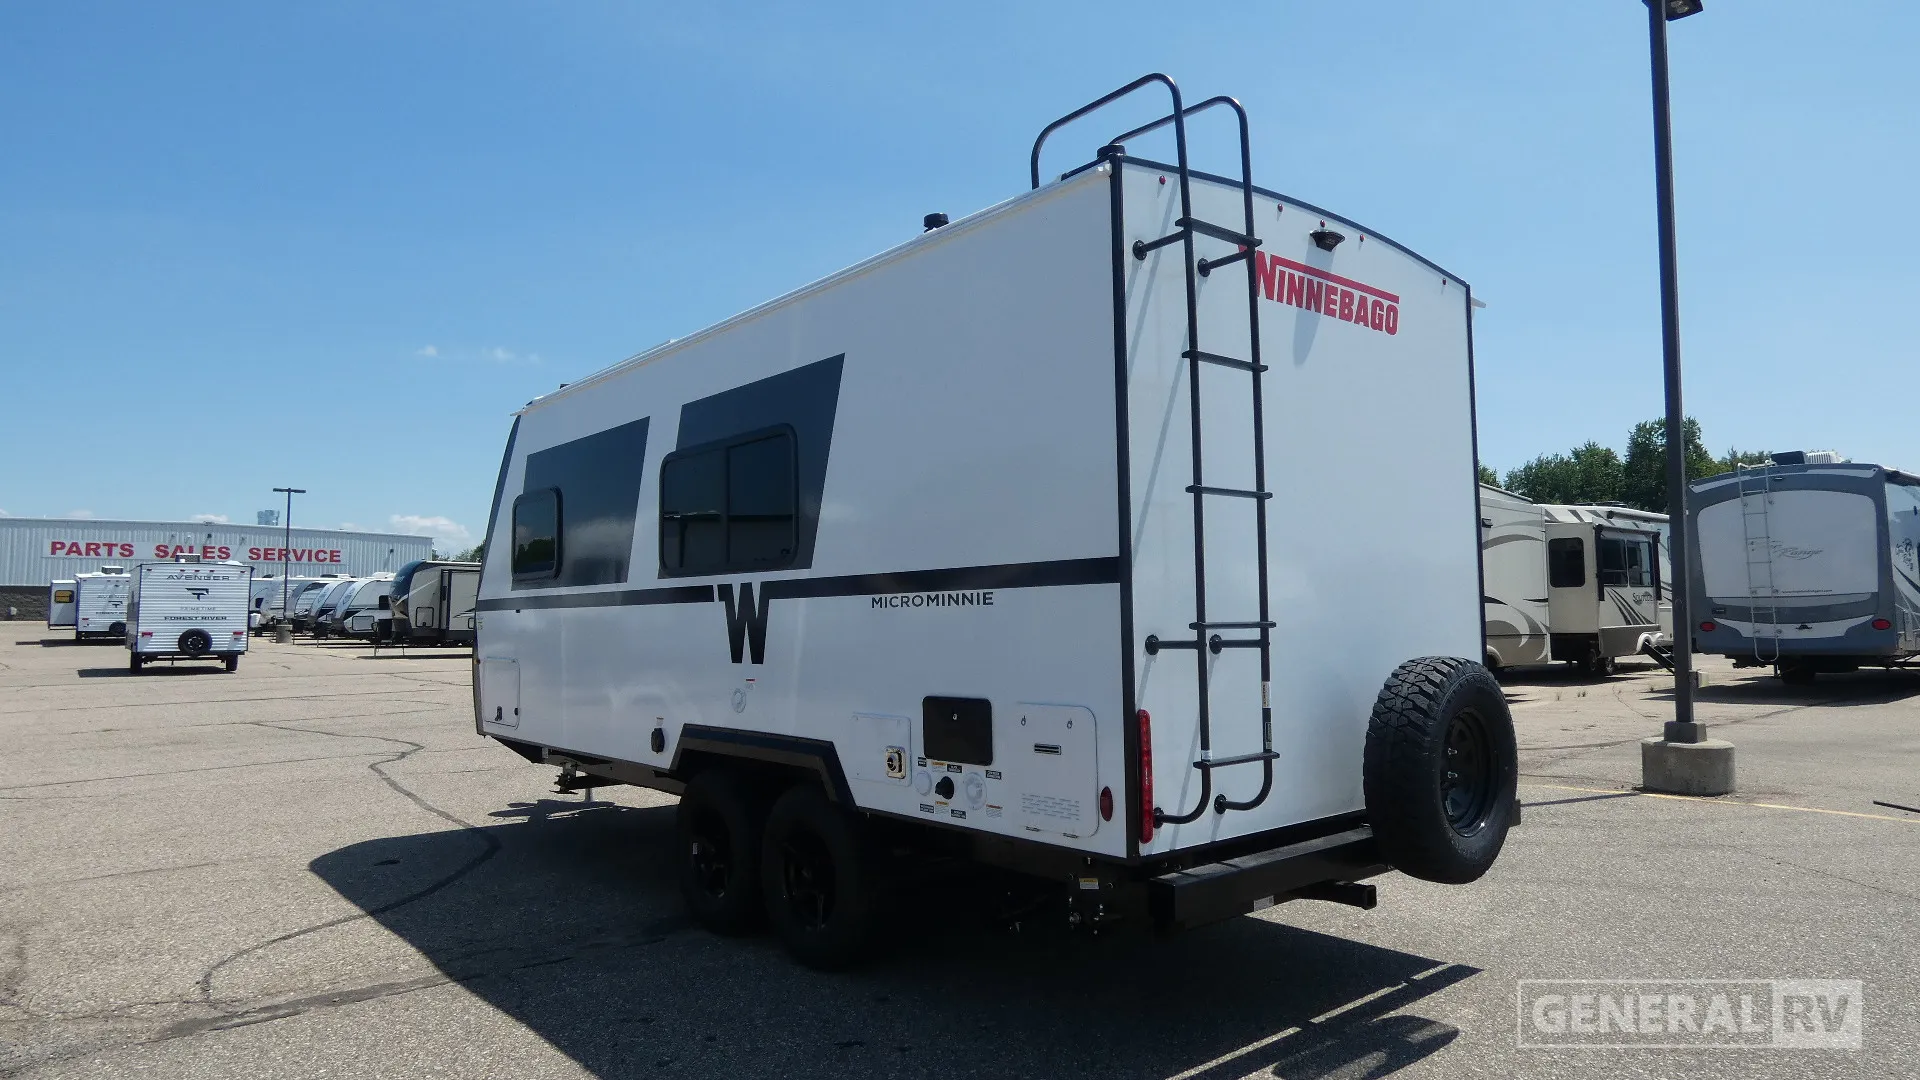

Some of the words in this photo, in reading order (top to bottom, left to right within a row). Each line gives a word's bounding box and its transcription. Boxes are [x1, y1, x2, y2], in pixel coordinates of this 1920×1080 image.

[1238, 245, 1400, 336] WINNEBAGO
[50, 541, 135, 558] PARTS
[248, 547, 342, 563] SERVICE
[717, 581, 772, 665] W
[871, 591, 995, 609] MICROMINNIE
